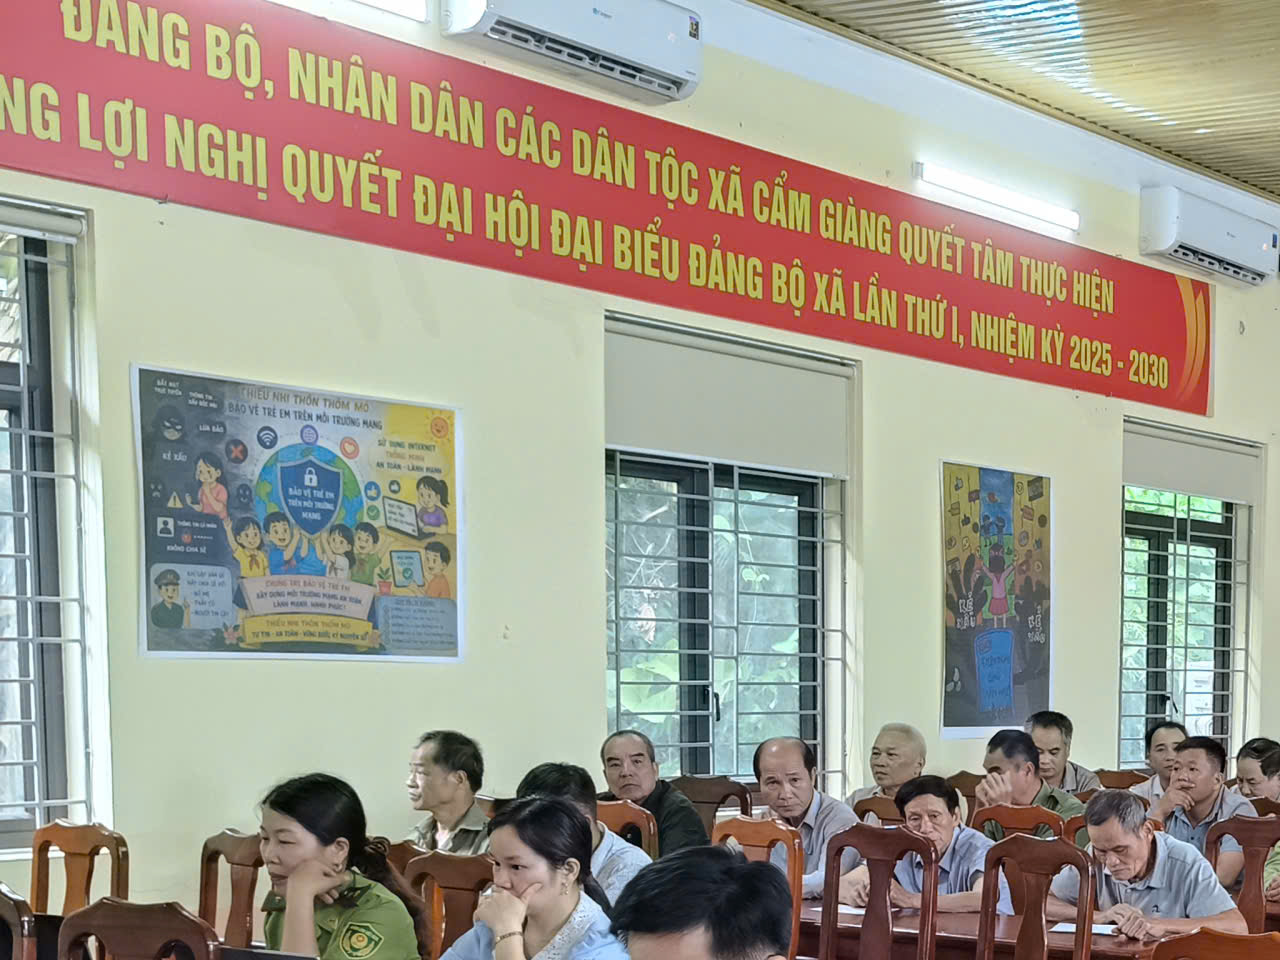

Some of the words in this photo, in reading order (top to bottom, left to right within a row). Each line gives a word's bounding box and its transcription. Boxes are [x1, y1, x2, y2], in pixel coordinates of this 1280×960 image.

[77, 92, 149, 169] LỢI
[163, 113, 269, 203] NGHỊ
[282, 147, 402, 219] QUYẾT
[413, 175, 472, 243] ĐẠI
[485, 189, 540, 259] HỘI
[550, 209, 603, 272] ĐẠI
[613, 215, 680, 283] BIỂU
[688, 233, 764, 301] ĐẢNG
[771, 258, 806, 317] BỘ
[813, 269, 847, 319] XÃ
[853, 271, 898, 330] LẦN
[905, 292, 947, 341] THỨ
[952, 309, 965, 351] I,
[970, 309, 1035, 365] NHIỆM
[1040, 323, 1066, 367] KỲ
[1069, 336, 1112, 378] 2025
[1128, 348, 1170, 390] 2030
[206, 23, 275, 100] BỘ,
[288, 48, 398, 126] NHÂN
[410, 80, 484, 149] DÂN
[496, 104, 561, 168] CÁC
[572, 126, 636, 190] DÂN
[645, 147, 699, 209] TỘC
[708, 166, 745, 218] XÃ
[752, 170, 812, 235] CẨM
[819, 196, 892, 255] GIÀNG
[899, 222, 965, 279] QUYẾT
[971, 235, 1014, 290] TÂM
[1020, 253, 1068, 310] THỰC
[1072, 267, 1115, 321] HIỆN
